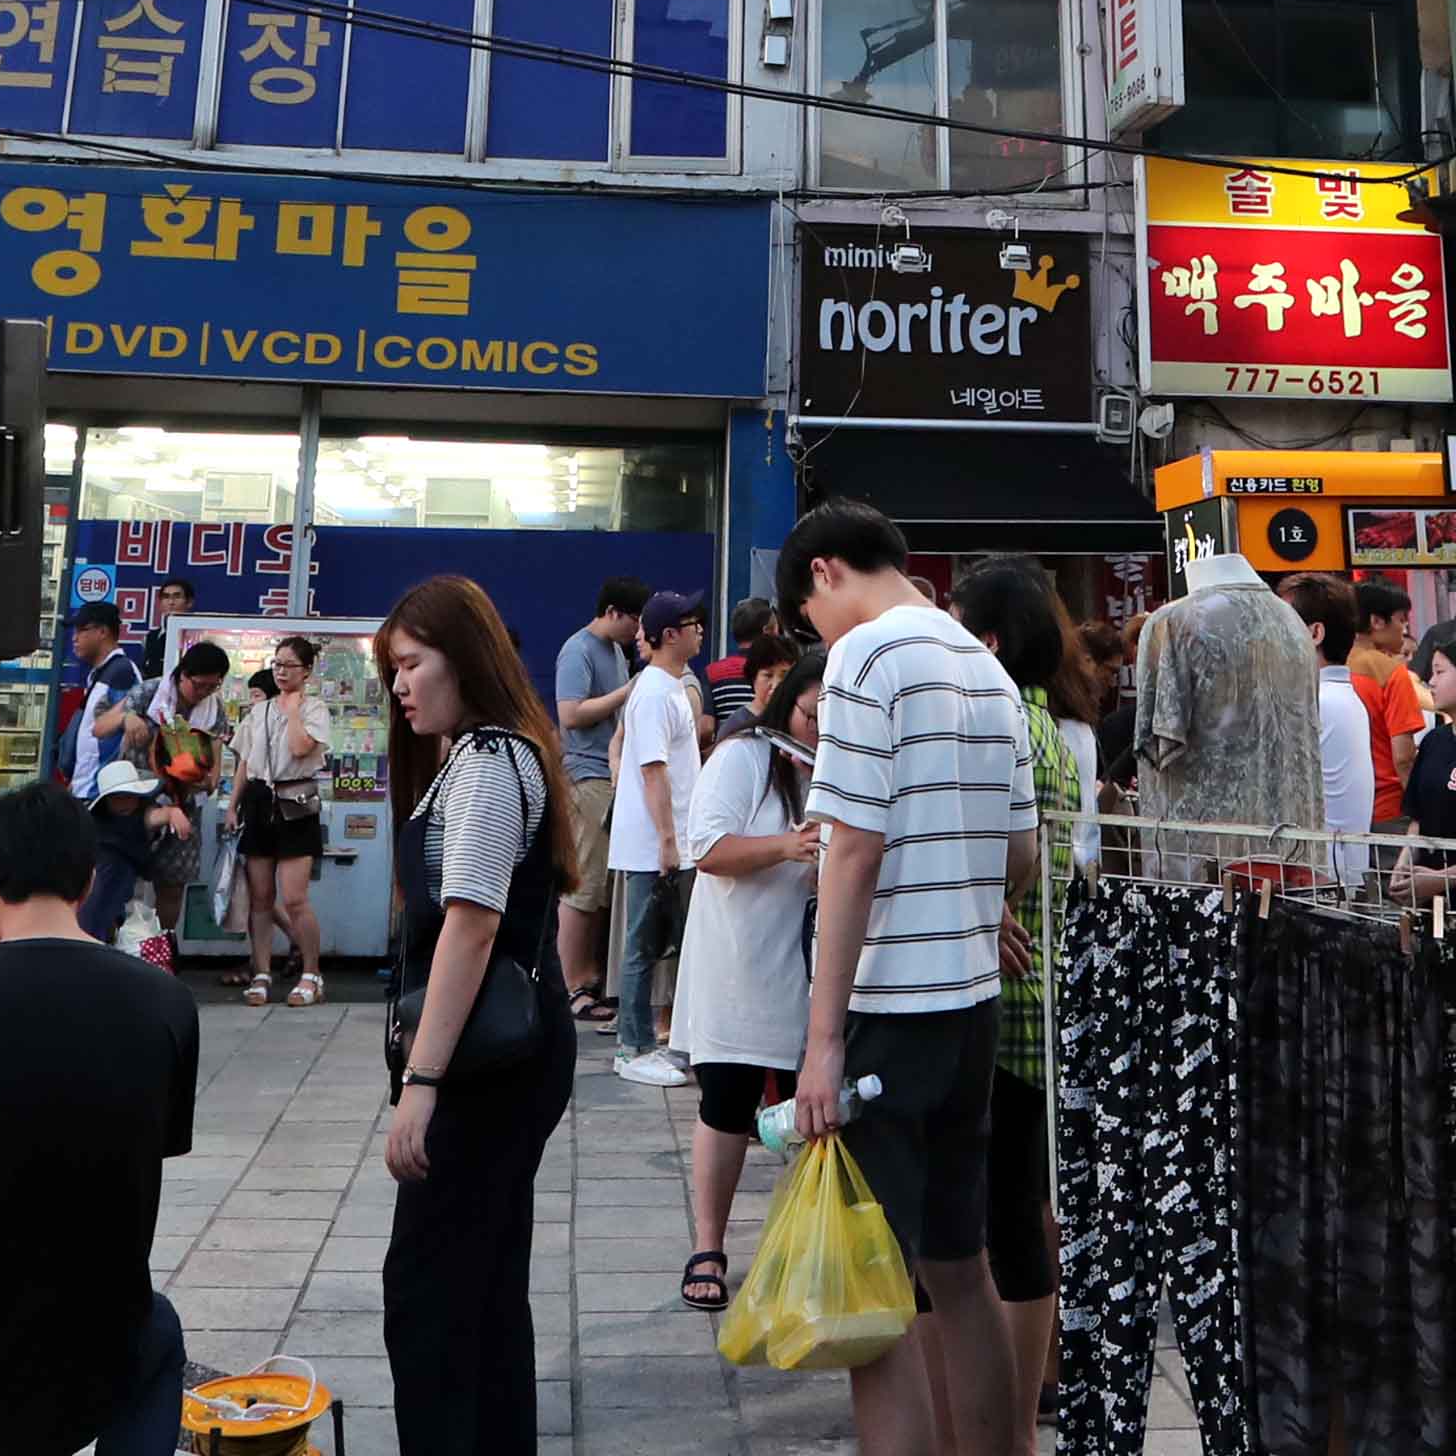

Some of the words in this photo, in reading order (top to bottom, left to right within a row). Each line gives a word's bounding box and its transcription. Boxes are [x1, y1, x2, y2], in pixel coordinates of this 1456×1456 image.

[0, 182, 478, 318] 영화마을
[819, 286, 1038, 356] noriter
[1161, 253, 1431, 339] 맥주마을
[65, 322, 188, 361] DVD
[223, 327, 343, 366] VCD
[373, 335, 600, 379] COMICS
[1225, 367, 1382, 396] 777-6521
[1230, 478, 1288, 493] 신용카드
[116, 519, 320, 576] 비디오
[1279, 526, 1308, 543] 1호
